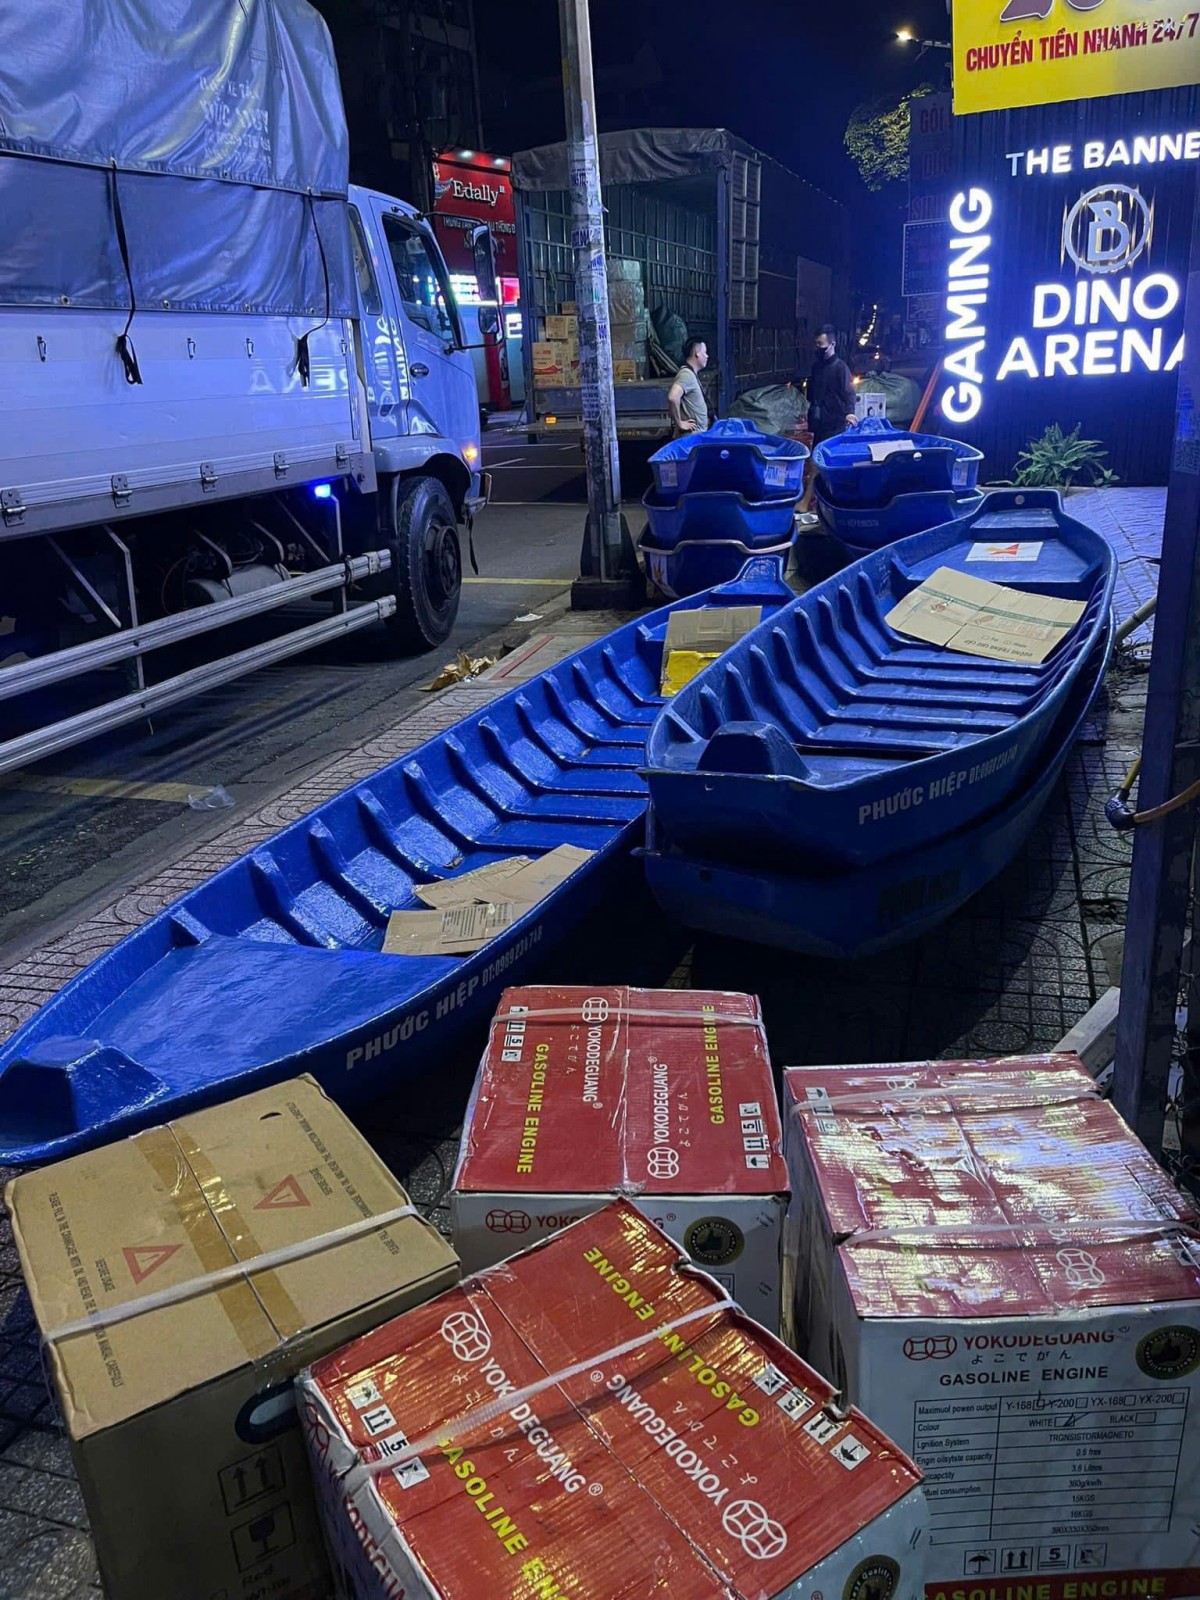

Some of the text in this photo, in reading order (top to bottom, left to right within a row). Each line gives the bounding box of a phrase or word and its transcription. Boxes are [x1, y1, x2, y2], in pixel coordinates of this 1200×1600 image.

[966, 14, 1200, 72] CHUYỂN TIỀN NHANH 24/7
[452, 180, 498, 206] Edally
[1006, 145, 1072, 176] THE
[942, 186, 993, 423] GAMING
[1032, 273, 1180, 328] DINO
[858, 784, 924, 825] PHƯỚC
[929, 770, 966, 800] HIỆP
[346, 1009, 430, 1070] PHƯỚC
[436, 976, 479, 1020] HIỆP
[582, 1025, 602, 1102] YOKODEGUANG
[706, 1055, 725, 1125] GASOLINE
[516, 1043, 549, 1174] GASOLINE ENGINE
[653, 1063, 670, 1145] YOKODEGUANG
[583, 1247, 656, 1321] ENGINE
[940, 1366, 1109, 1386] GASOLINE ENGINE
[1006, 1401, 1031, 1411] Y-168
[452, 1368, 521, 1463] よこがん
[479, 1358, 586, 1494] YOKDEGUANG
[606, 1374, 730, 1506] YOKODEGUANG
[918, 1423, 940, 1432] Colour
[1029, 1419, 1052, 1428] WHITE
[437, 1439, 569, 1600] ASOLINE EN
[1064, 1577, 1165, 1598] ENGINE
